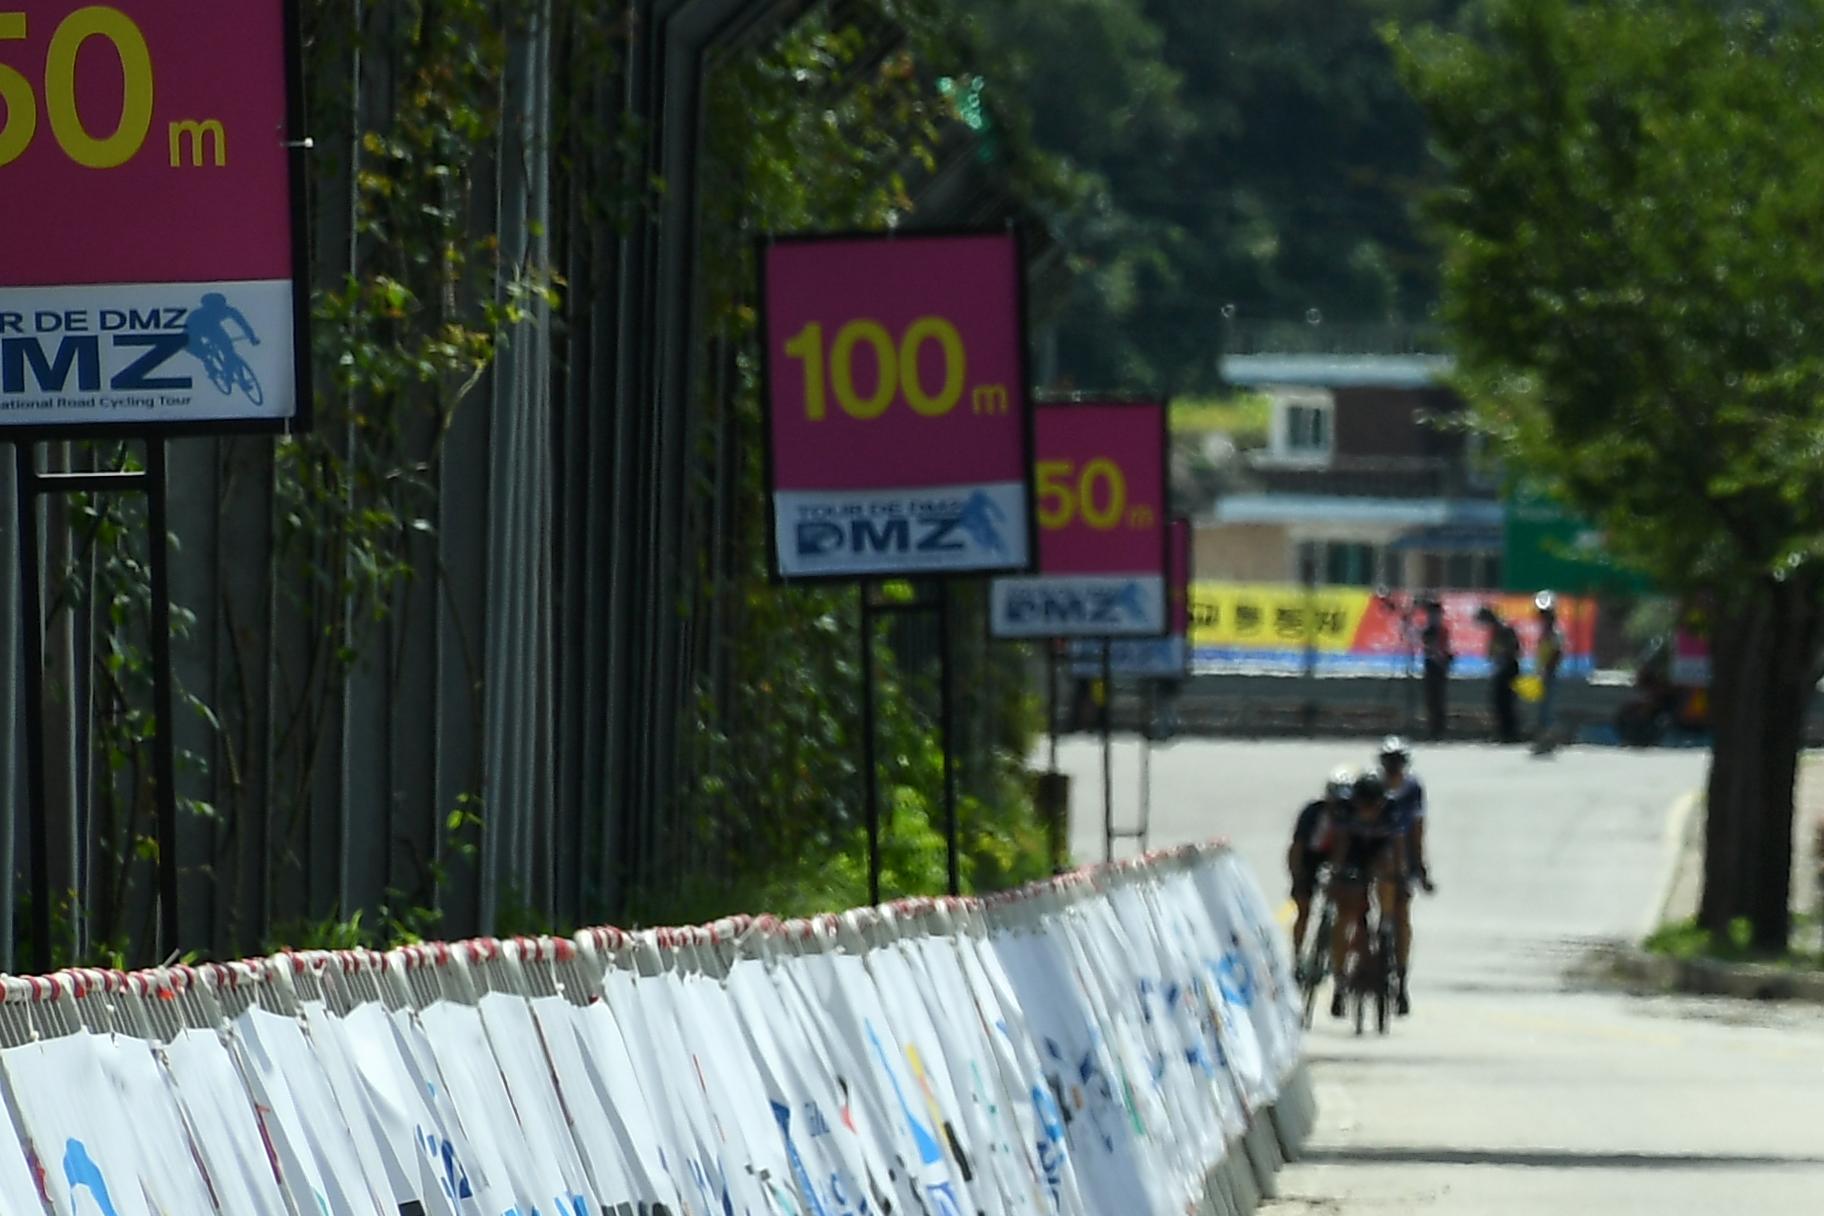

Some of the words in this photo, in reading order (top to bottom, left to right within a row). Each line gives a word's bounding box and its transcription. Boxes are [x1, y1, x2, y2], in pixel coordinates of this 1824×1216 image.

[35, 310, 88, 333] DE
[100, 308, 188, 331] DMZ
[57, 397, 96, 408] Road
[100, 396, 155, 410] Cycling
[161, 395, 191, 407] Tour
[797, 517, 965, 554] DMZ
